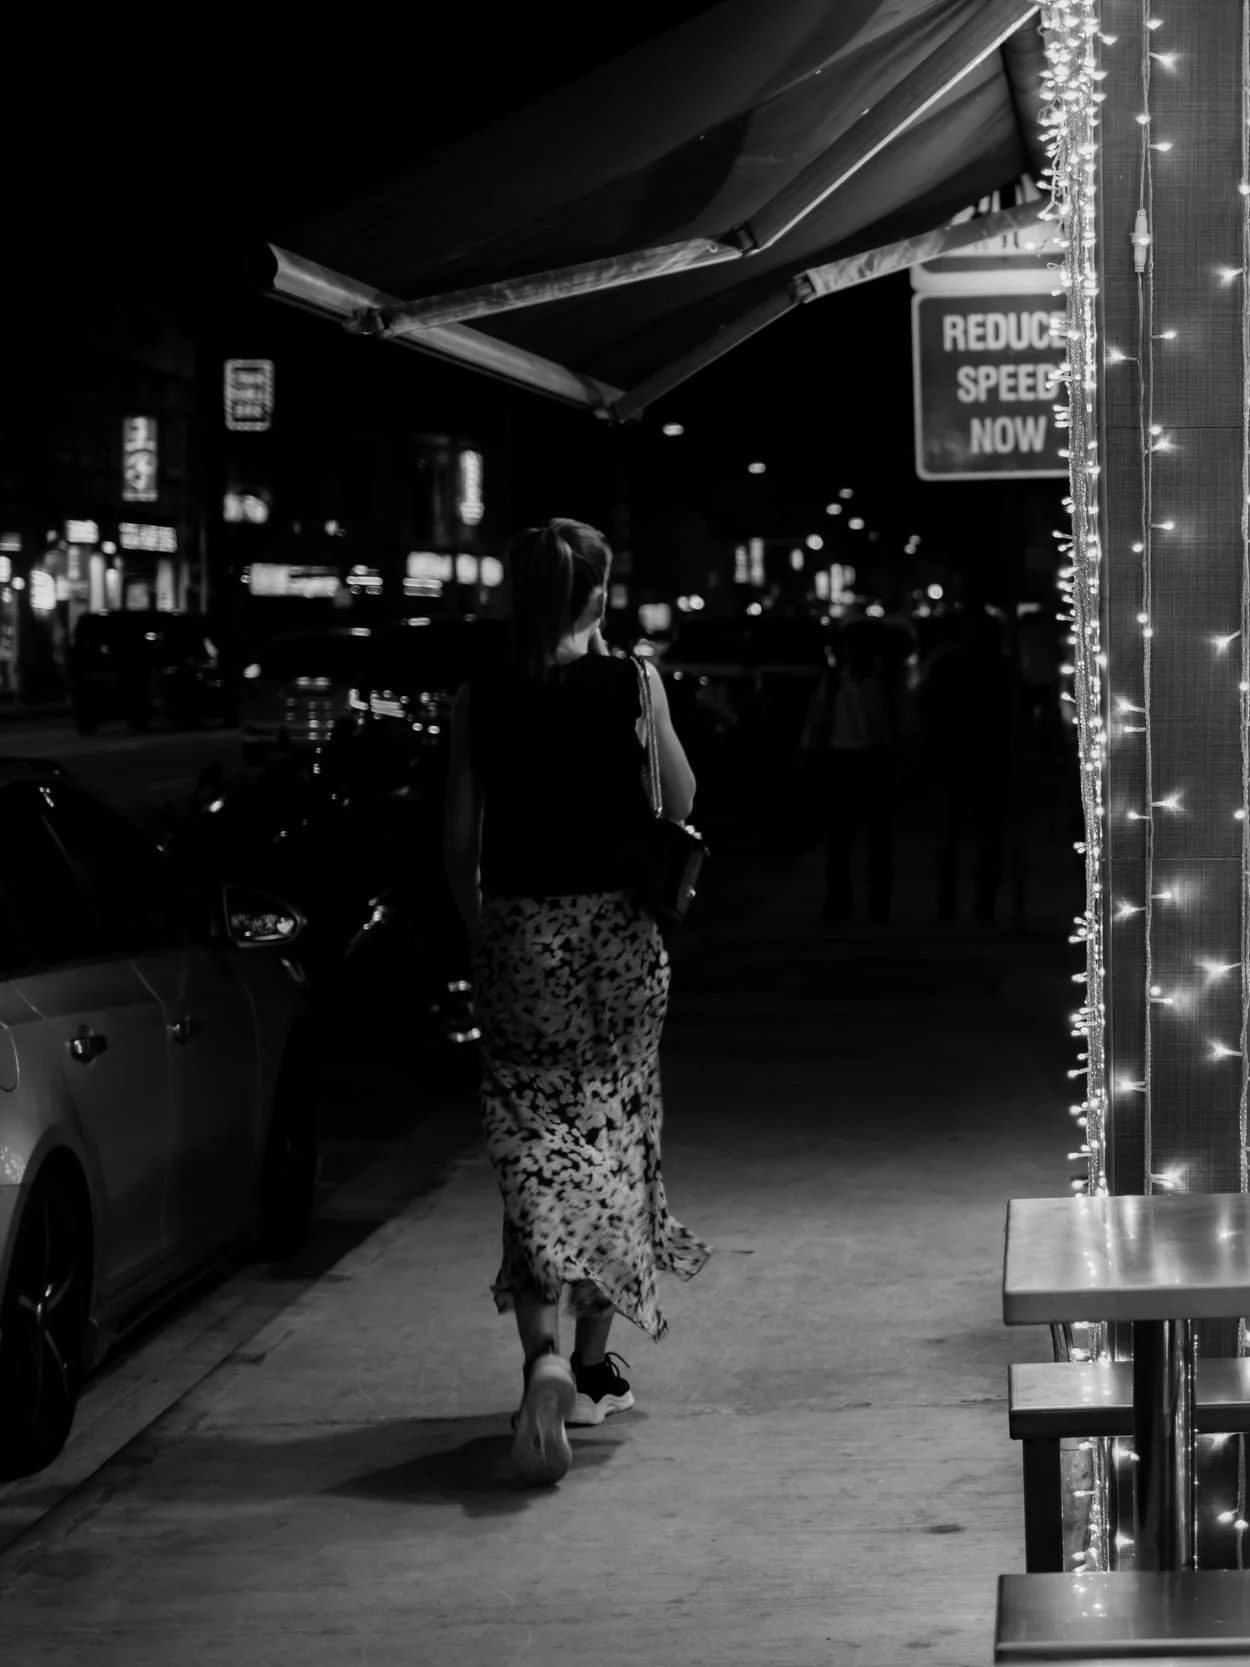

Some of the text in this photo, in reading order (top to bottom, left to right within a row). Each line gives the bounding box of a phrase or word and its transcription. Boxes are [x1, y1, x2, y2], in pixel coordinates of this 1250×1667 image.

[942, 311, 1067, 351] REDUCE
[956, 363, 1059, 404] SPEED
[970, 415, 1047, 455] NOW
